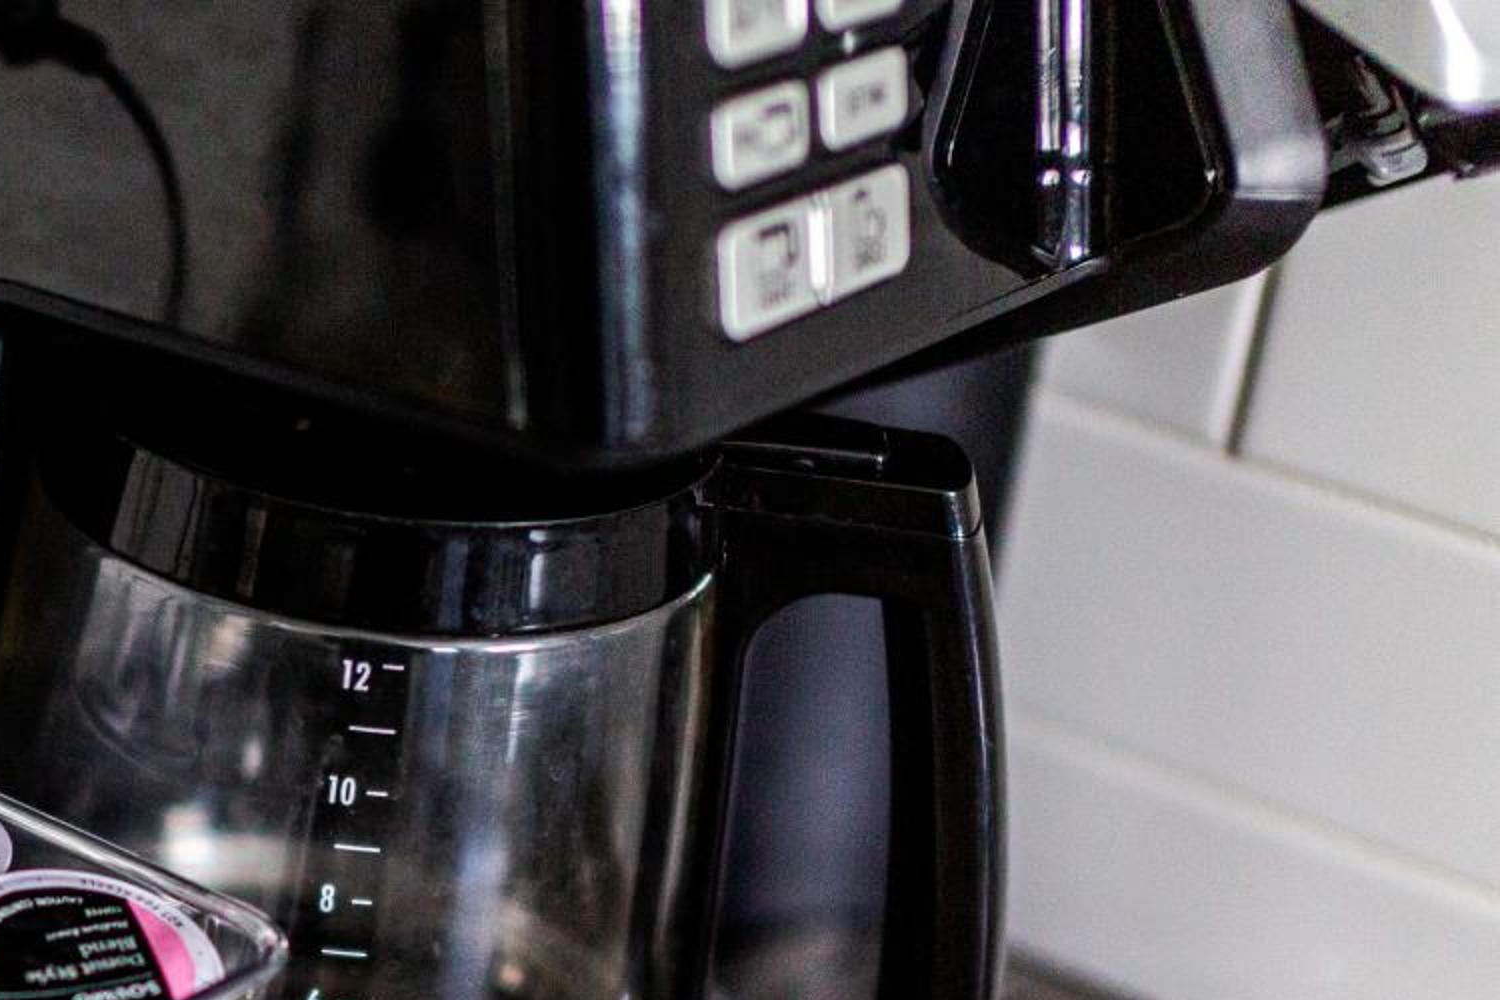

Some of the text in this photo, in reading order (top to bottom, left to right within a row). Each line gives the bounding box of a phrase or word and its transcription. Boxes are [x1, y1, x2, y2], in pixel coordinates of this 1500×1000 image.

[341, 659, 371, 692] 12
[327, 775, 357, 806] 10
[318, 884, 335, 913] 8
[78, 935, 138, 959] Blend
[25, 952, 146, 986] Donut Style
